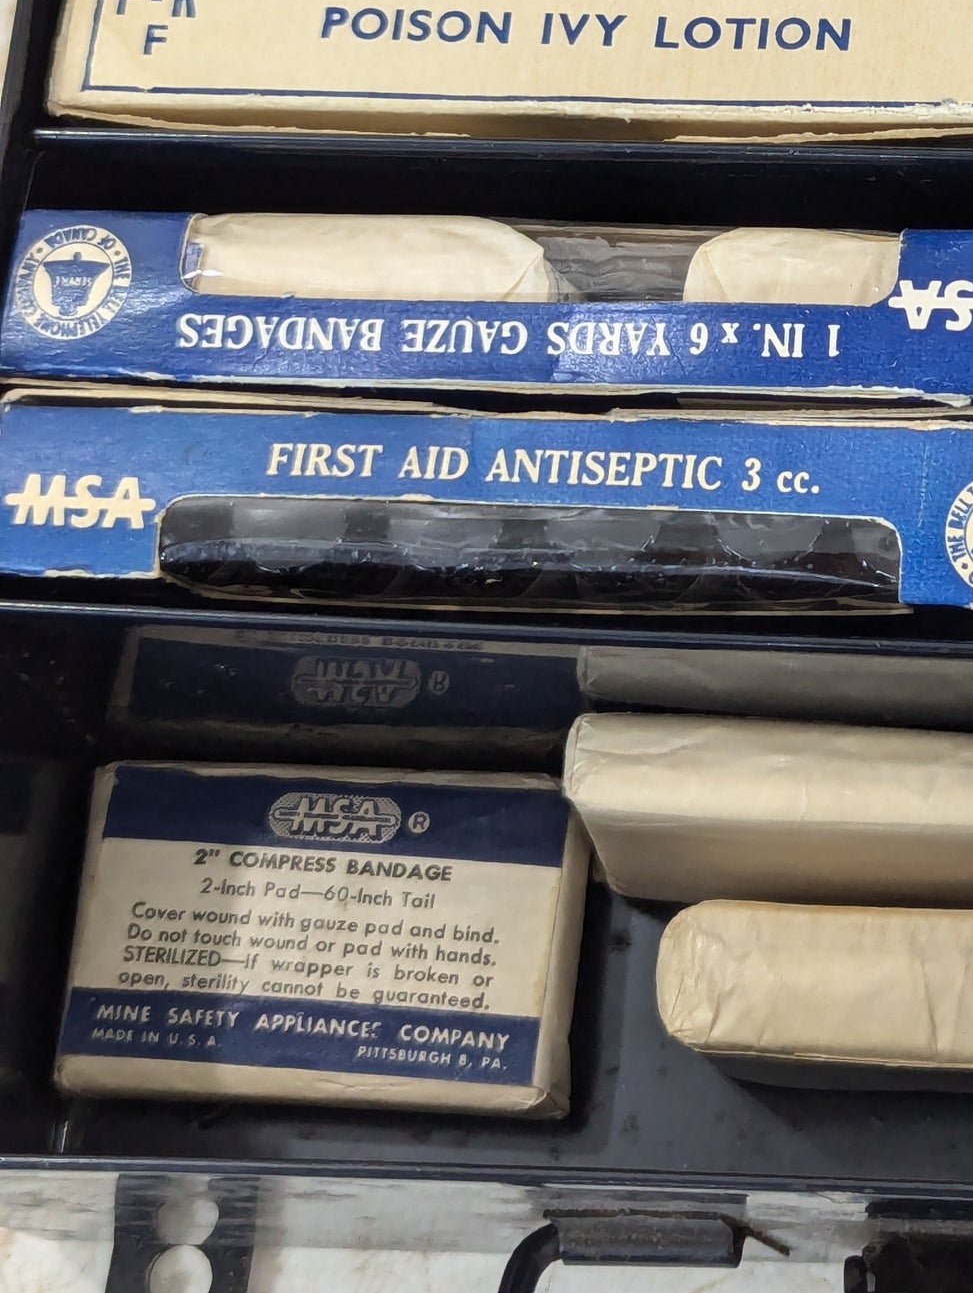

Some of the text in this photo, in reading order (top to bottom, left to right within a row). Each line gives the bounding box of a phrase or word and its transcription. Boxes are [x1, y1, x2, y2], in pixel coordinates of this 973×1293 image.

[143, 24, 169, 55] F
[321, 6, 852, 52] POISON IVY LOTION
[178, 313, 383, 351] BANDAGES
[403, 318, 529, 356] GAUZE
[546, 321, 671, 357] YARDS
[689, 322, 710, 357] 6
[754, 321, 804, 359] IN.
[827, 323, 841, 358] 1
[266, 443, 820, 496] FIRST AID ANTISEPTIC 3 cc.
[5, 474, 156, 530] MSA
[270, 794, 401, 841] MSA
[229, 850, 337, 873] COMPRESS
[346, 859, 453, 882] BANDAGE
[199, 877, 256, 898] 2-Inch
[402, 891, 435, 909] Tail
[131, 901, 500, 945] Cover wound with gauze pad and bind.
[127, 922, 497, 967] Do not touch wound or pad with hands.
[118, 970, 490, 1010] open, sterility cannot be guaranteed.
[271, 958, 353, 979] wrapper
[366, 963, 380, 979] is
[394, 963, 459, 986] broken
[472, 974, 494, 988] or
[91, 1027, 135, 1043] MADE
[141, 1030, 160, 1044] IN
[96, 1004, 152, 1023] MINE
[167, 1007, 240, 1028] SAFETY
[400, 1023, 511, 1051] COMPANY
[356, 1044, 452, 1066] PITTSBURGH
[481, 1056, 508, 1071] PA.
